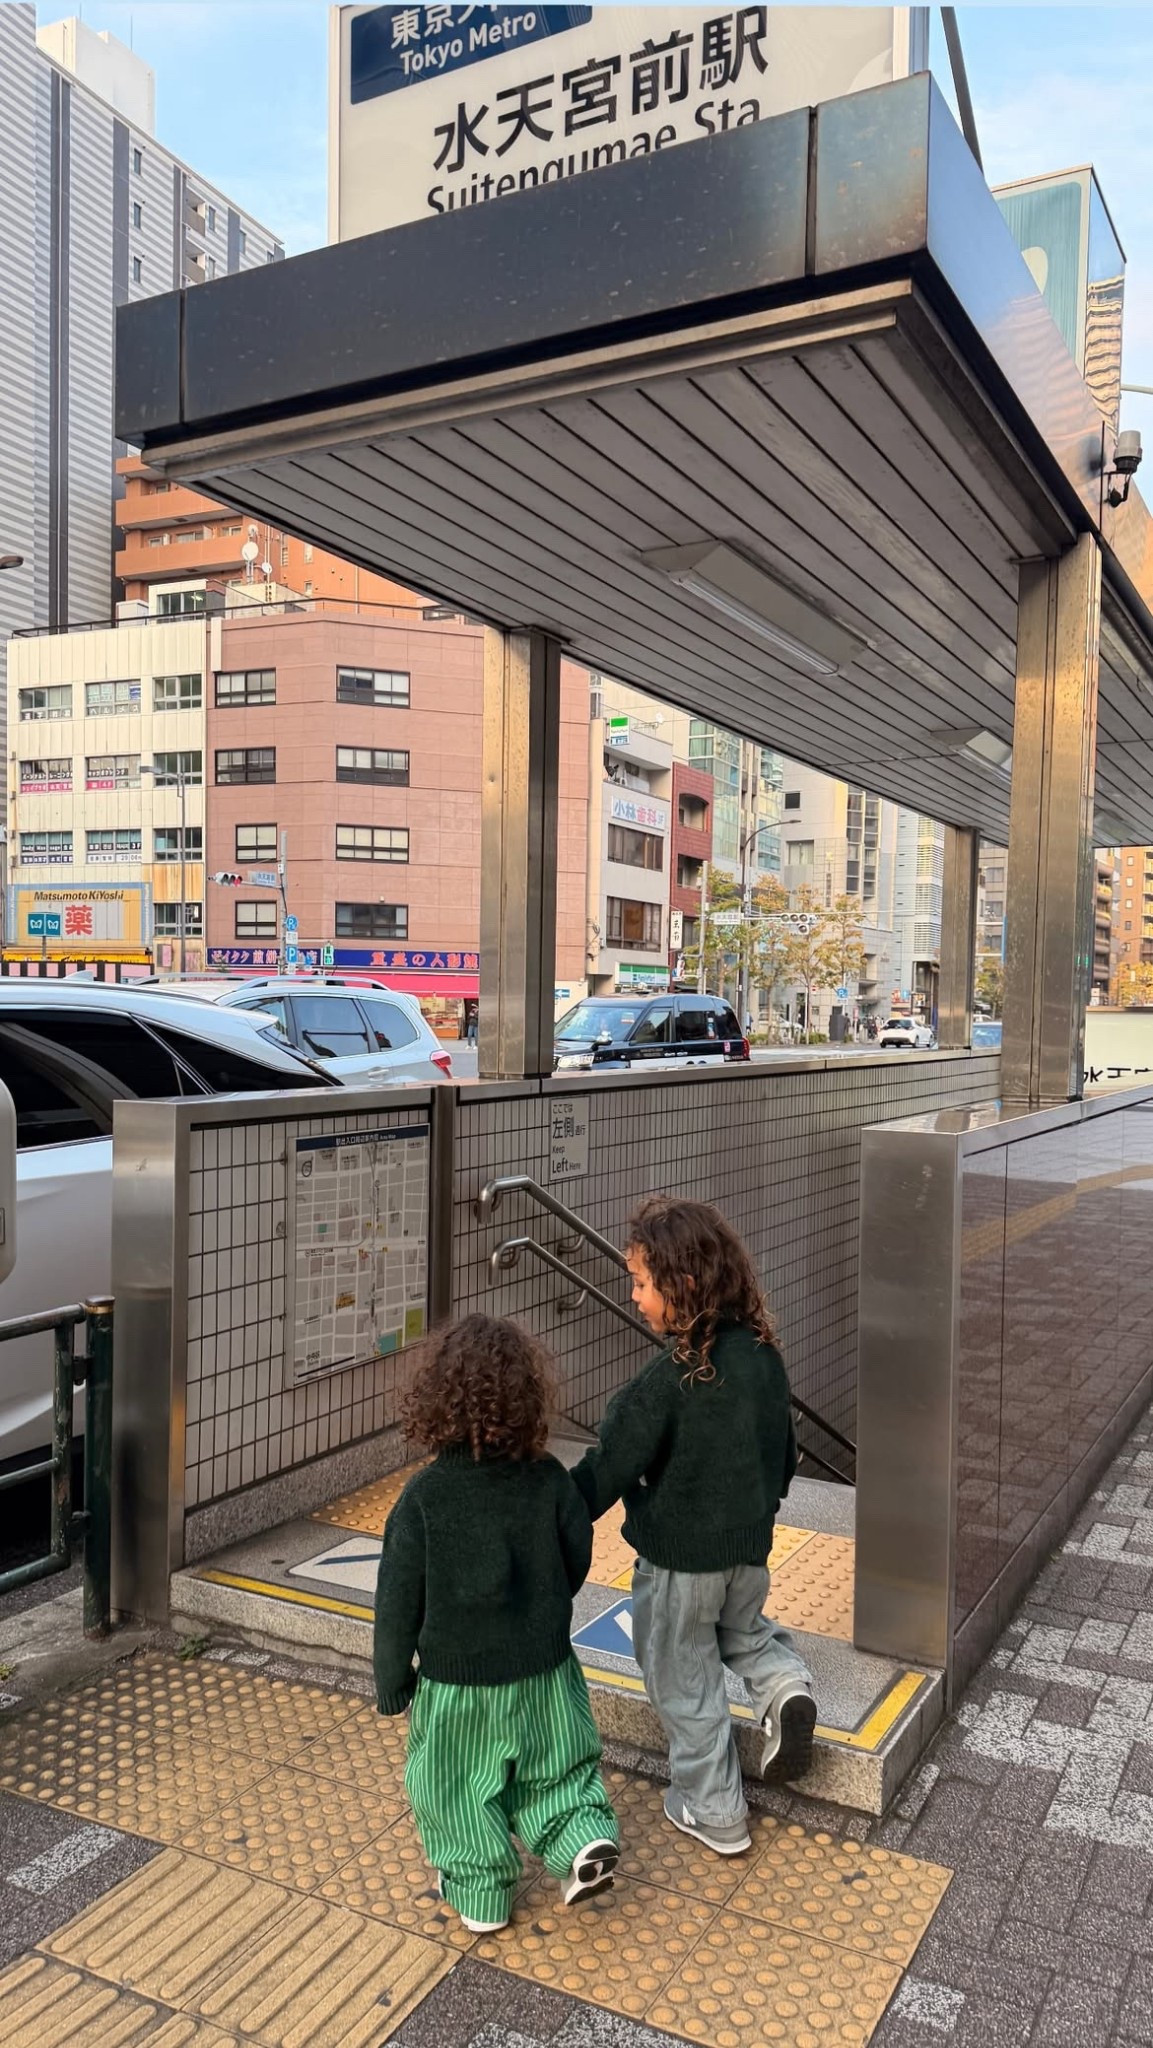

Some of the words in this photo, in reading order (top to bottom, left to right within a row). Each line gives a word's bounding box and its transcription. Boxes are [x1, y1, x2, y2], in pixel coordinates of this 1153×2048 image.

[400, 38, 463, 75] Tokyo
[469, 11, 537, 52] Metro
[433, 6, 768, 174] 水天宮前駅
[65, 904, 93, 936] 薬
[552, 1103, 573, 1114] ここでは
[552, 1145, 566, 1155] Keep
[552, 1157, 568, 1174] Left
